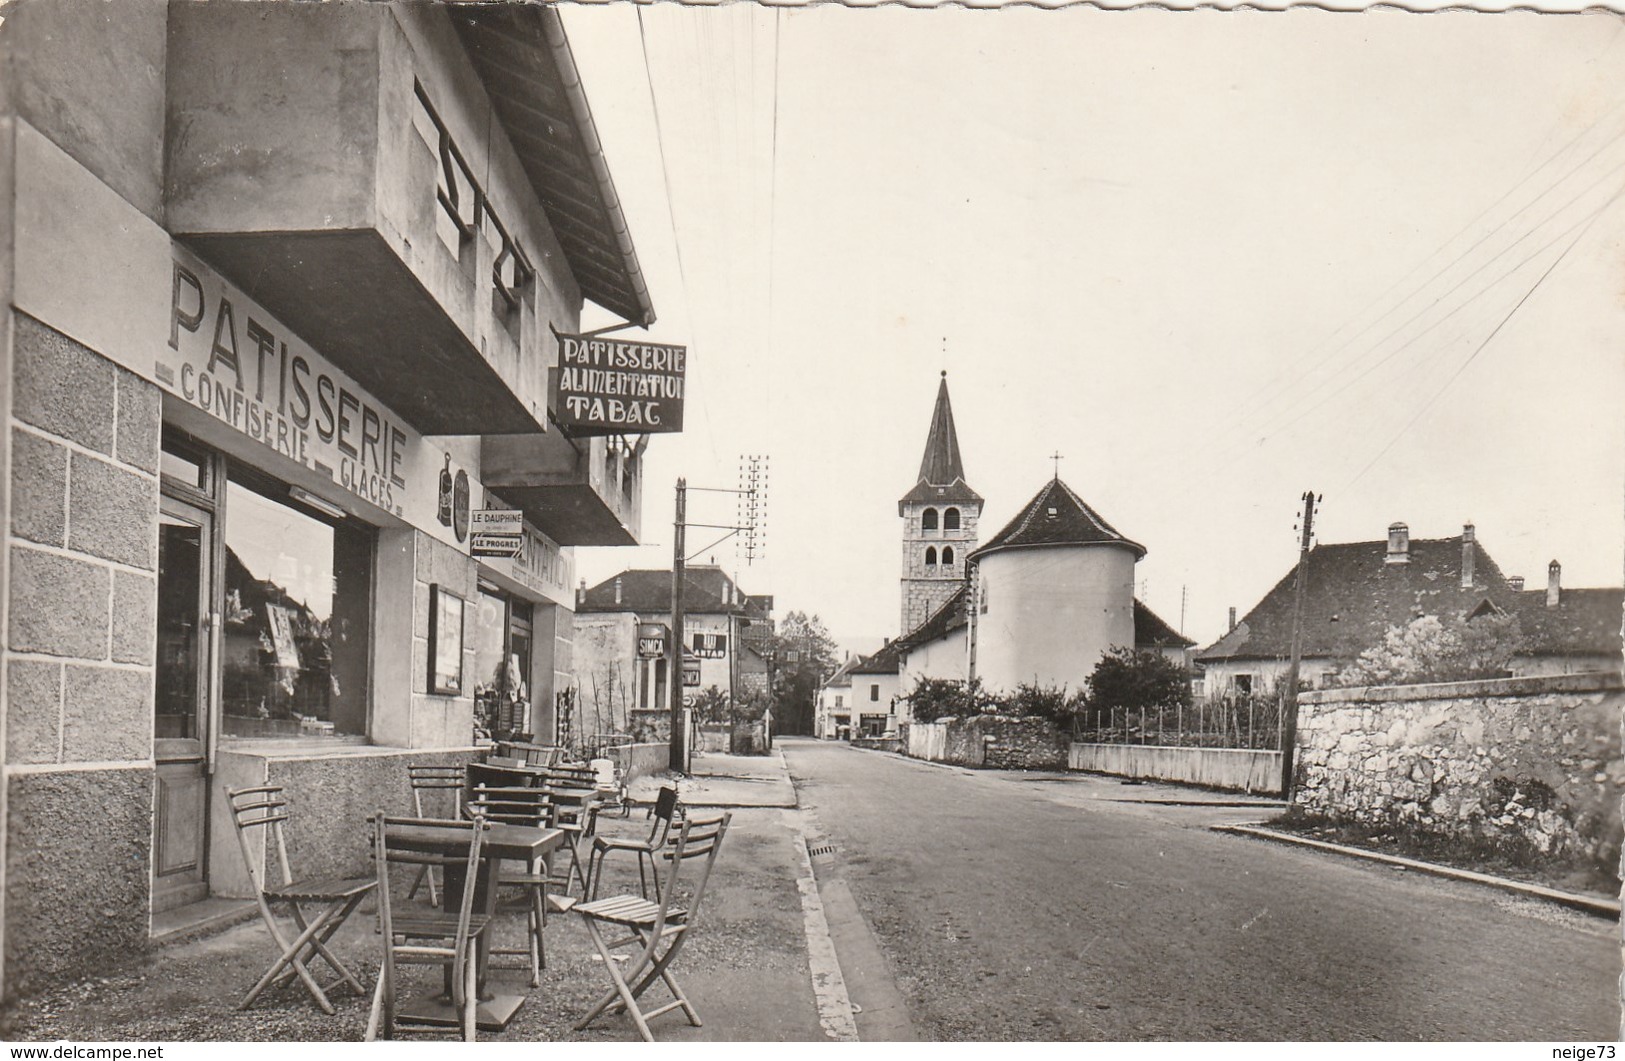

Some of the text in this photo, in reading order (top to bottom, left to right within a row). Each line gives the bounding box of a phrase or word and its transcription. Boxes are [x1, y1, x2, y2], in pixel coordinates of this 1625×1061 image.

[564, 338, 684, 373] PATISSERIE
[168, 256, 406, 490] PATISSERIE
[560, 367, 684, 400] ALIMENTATION
[566, 396, 660, 425] TABAC
[181, 362, 309, 463] CONFISERIE
[340, 457, 393, 511] GLACES
[473, 514, 482, 523] LE
[640, 639, 664, 655] SIMCA
[693, 649, 725, 657] ANTAR
